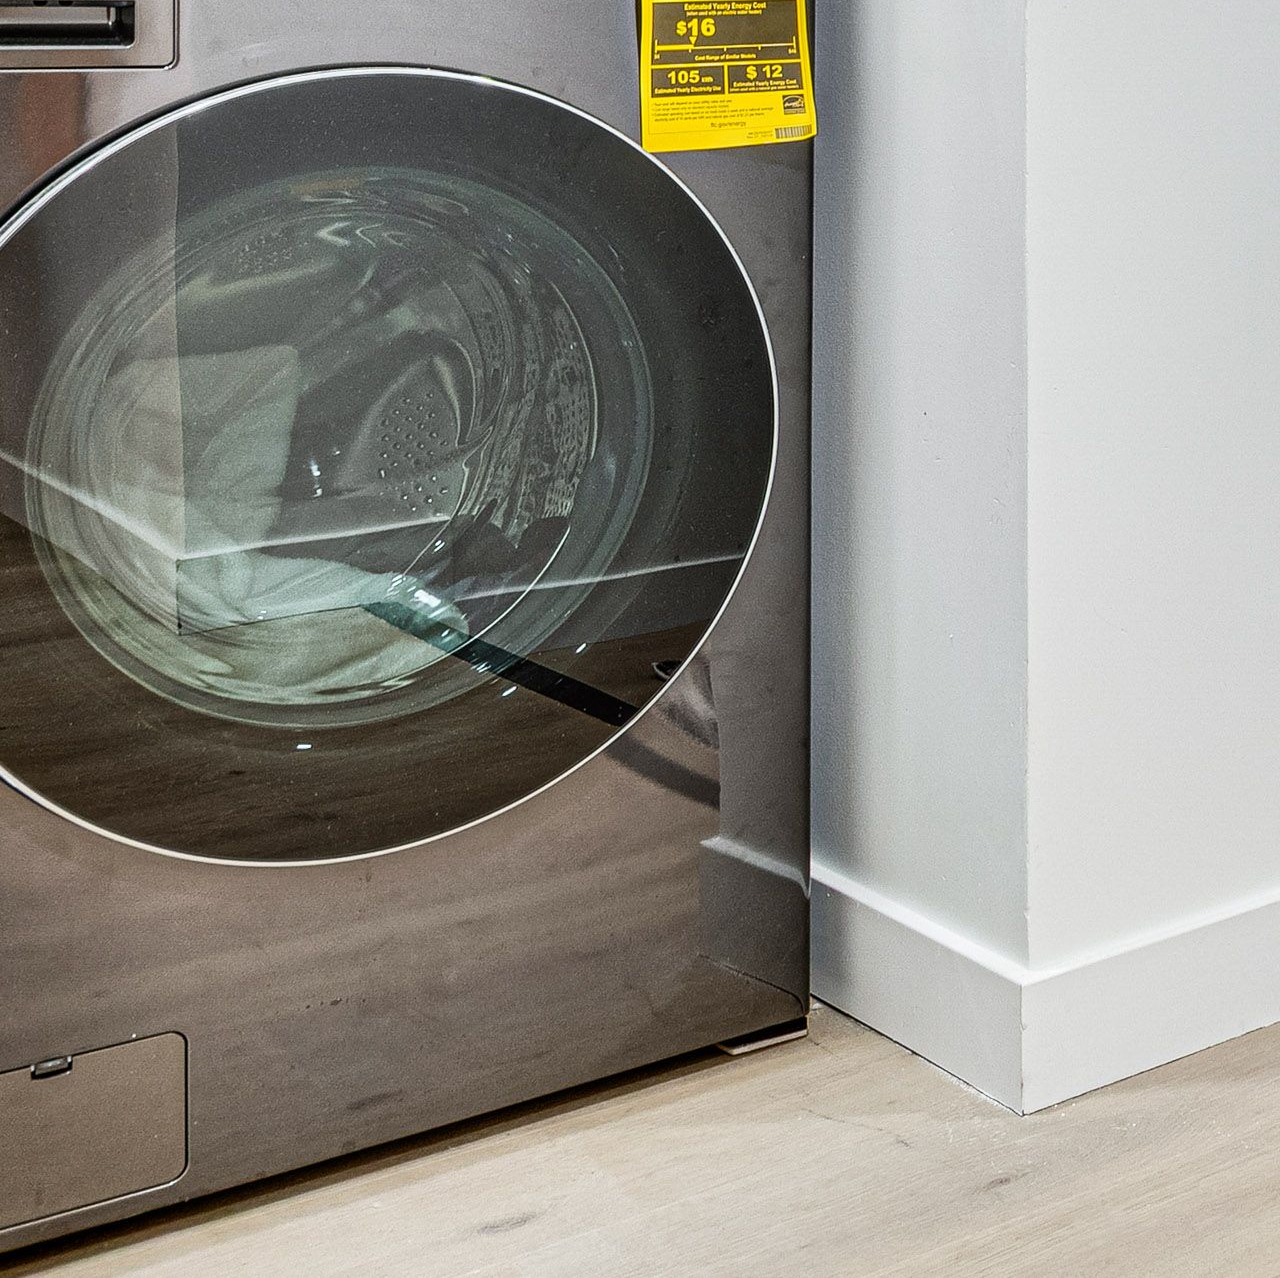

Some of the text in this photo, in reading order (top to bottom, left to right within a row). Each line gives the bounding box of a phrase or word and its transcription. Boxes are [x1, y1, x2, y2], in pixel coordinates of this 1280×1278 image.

[675, 17, 716, 37] $16
[667, 70, 700, 85] 105
[746, 65, 783, 80] $ 12
